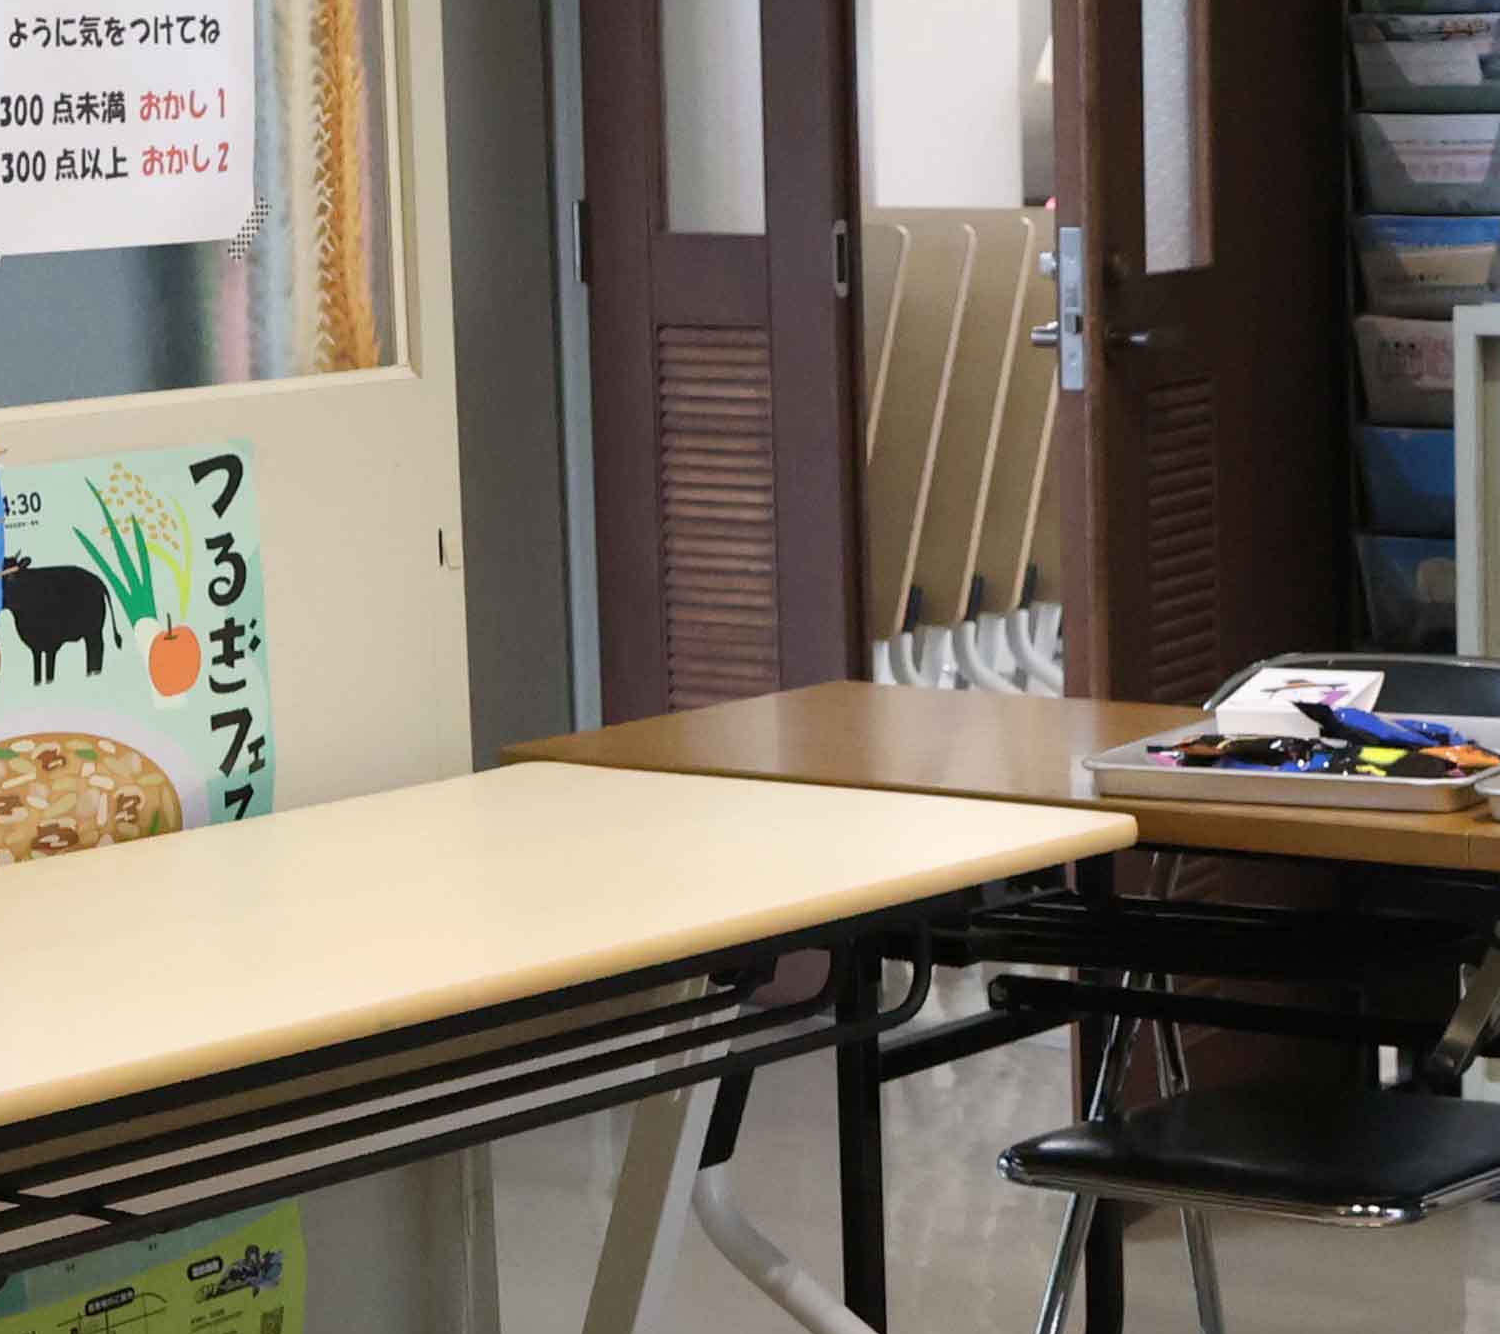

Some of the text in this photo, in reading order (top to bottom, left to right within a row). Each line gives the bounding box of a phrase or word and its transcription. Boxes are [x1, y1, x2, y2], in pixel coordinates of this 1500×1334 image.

[7, 14, 221, 51] ように気をつけてね
